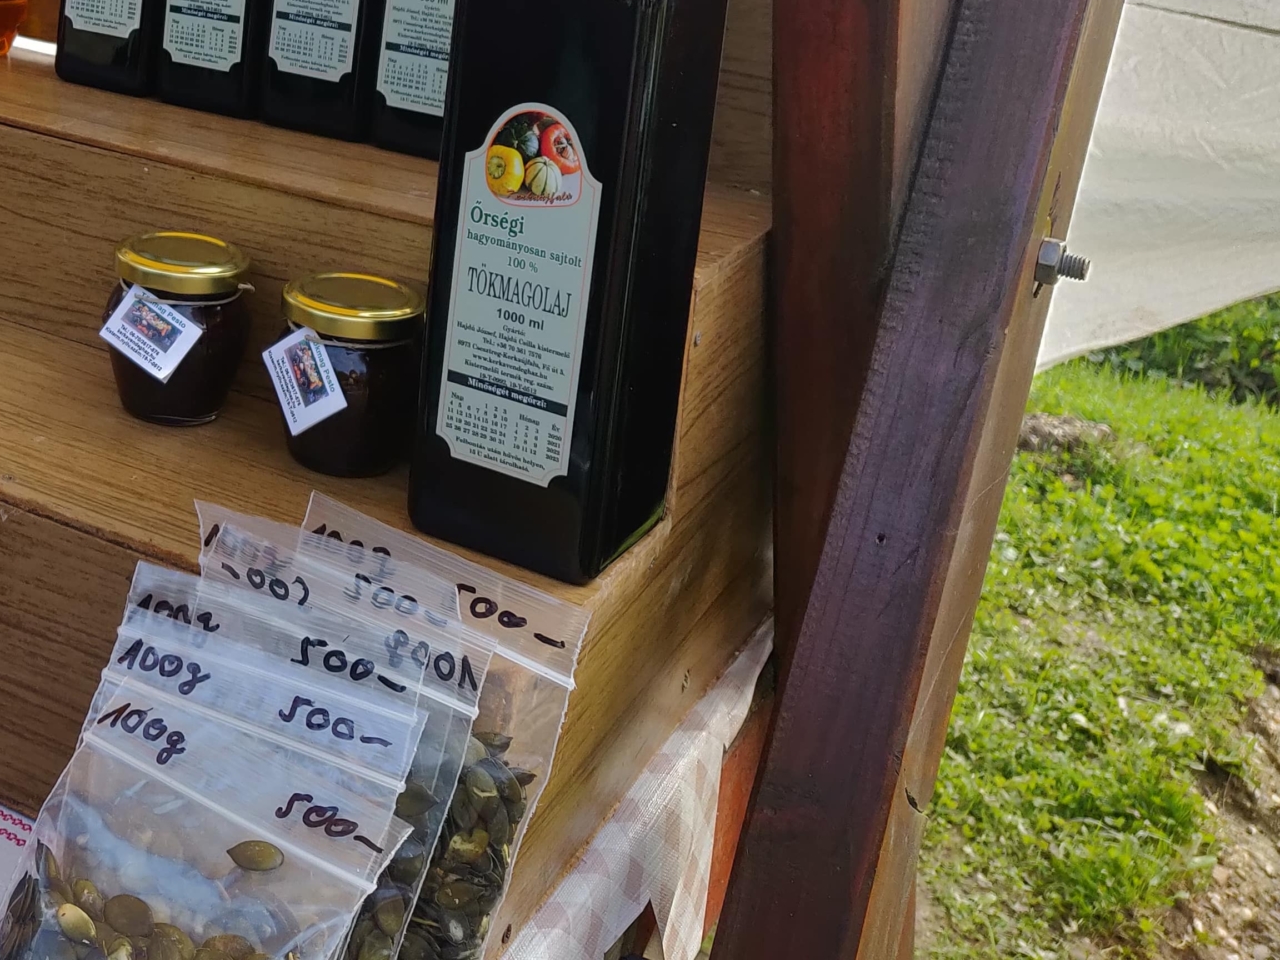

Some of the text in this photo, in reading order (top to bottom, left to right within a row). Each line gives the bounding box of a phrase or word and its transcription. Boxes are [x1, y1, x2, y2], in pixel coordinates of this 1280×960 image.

[470, 200, 525, 238] Őrségi
[466, 228, 582, 268] hagyományosan sajtolt
[507, 256, 539, 274] 100 %
[167, 311, 187, 329] Pesto
[496, 307, 544, 331] 1000 ml
[322, 369, 336, 393] Pesto
[117, 637, 212, 696] 100g
[96, 702, 187, 766] 100g
